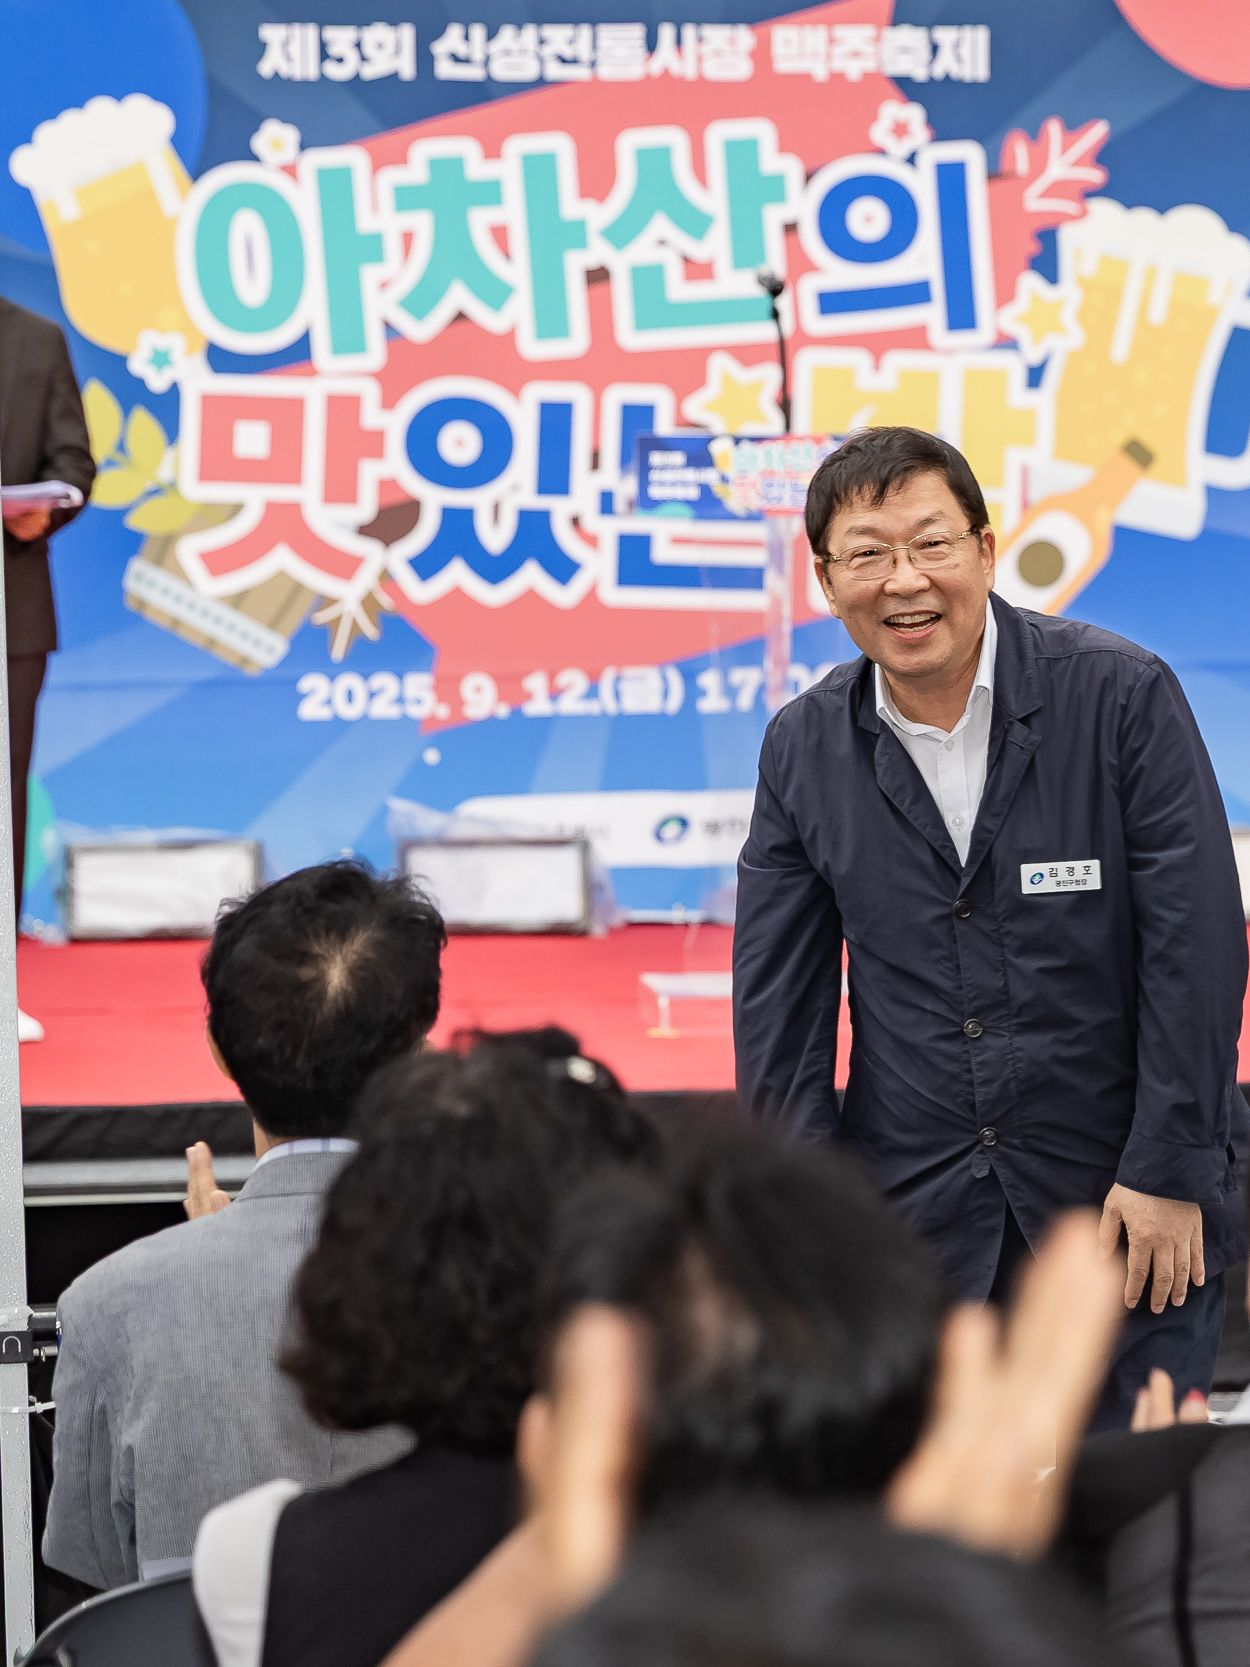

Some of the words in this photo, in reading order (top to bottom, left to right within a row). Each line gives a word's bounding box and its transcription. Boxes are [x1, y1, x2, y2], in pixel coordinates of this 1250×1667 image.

[257, 22, 417, 82] 제3회
[430, 22, 756, 82] 신성전통시장
[770, 23, 991, 83] 맥주축제
[186, 126, 990, 364] 아차산의
[297, 671, 451, 722] 2025.
[458, 672, 510, 721] 9.
[1055, 878, 1087, 887] 광진구청장
